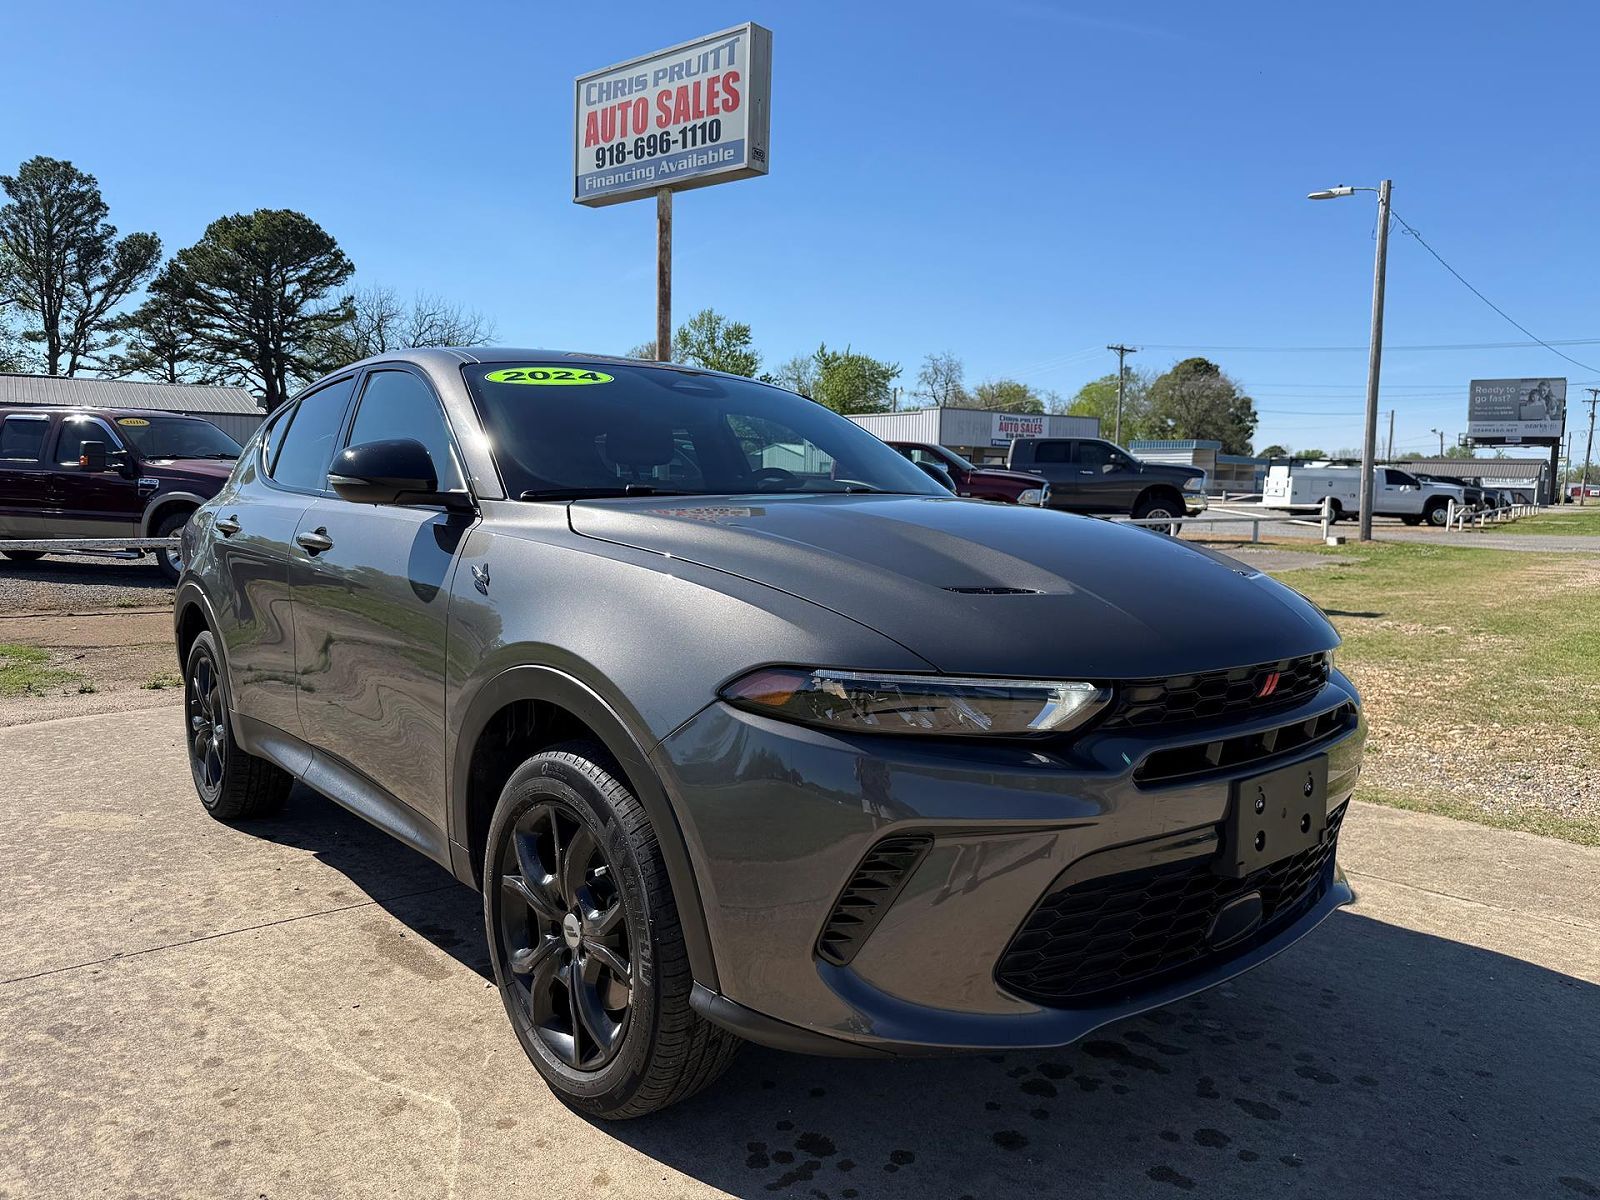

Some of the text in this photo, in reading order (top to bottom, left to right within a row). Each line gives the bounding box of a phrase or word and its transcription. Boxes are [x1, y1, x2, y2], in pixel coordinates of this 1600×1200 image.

[585, 36, 740, 107] CHRIS PRUITT
[584, 70, 741, 148] AUTO SALES
[595, 118, 721, 170] 918-696-1110
[585, 165, 655, 191] Financing
[658, 147, 735, 175] Available
[502, 370, 603, 381] 2024
[1474, 394, 1511, 404] go fast?
[1475, 386, 1505, 395] Ready
[999, 422, 1043, 434] AUTO SALES
